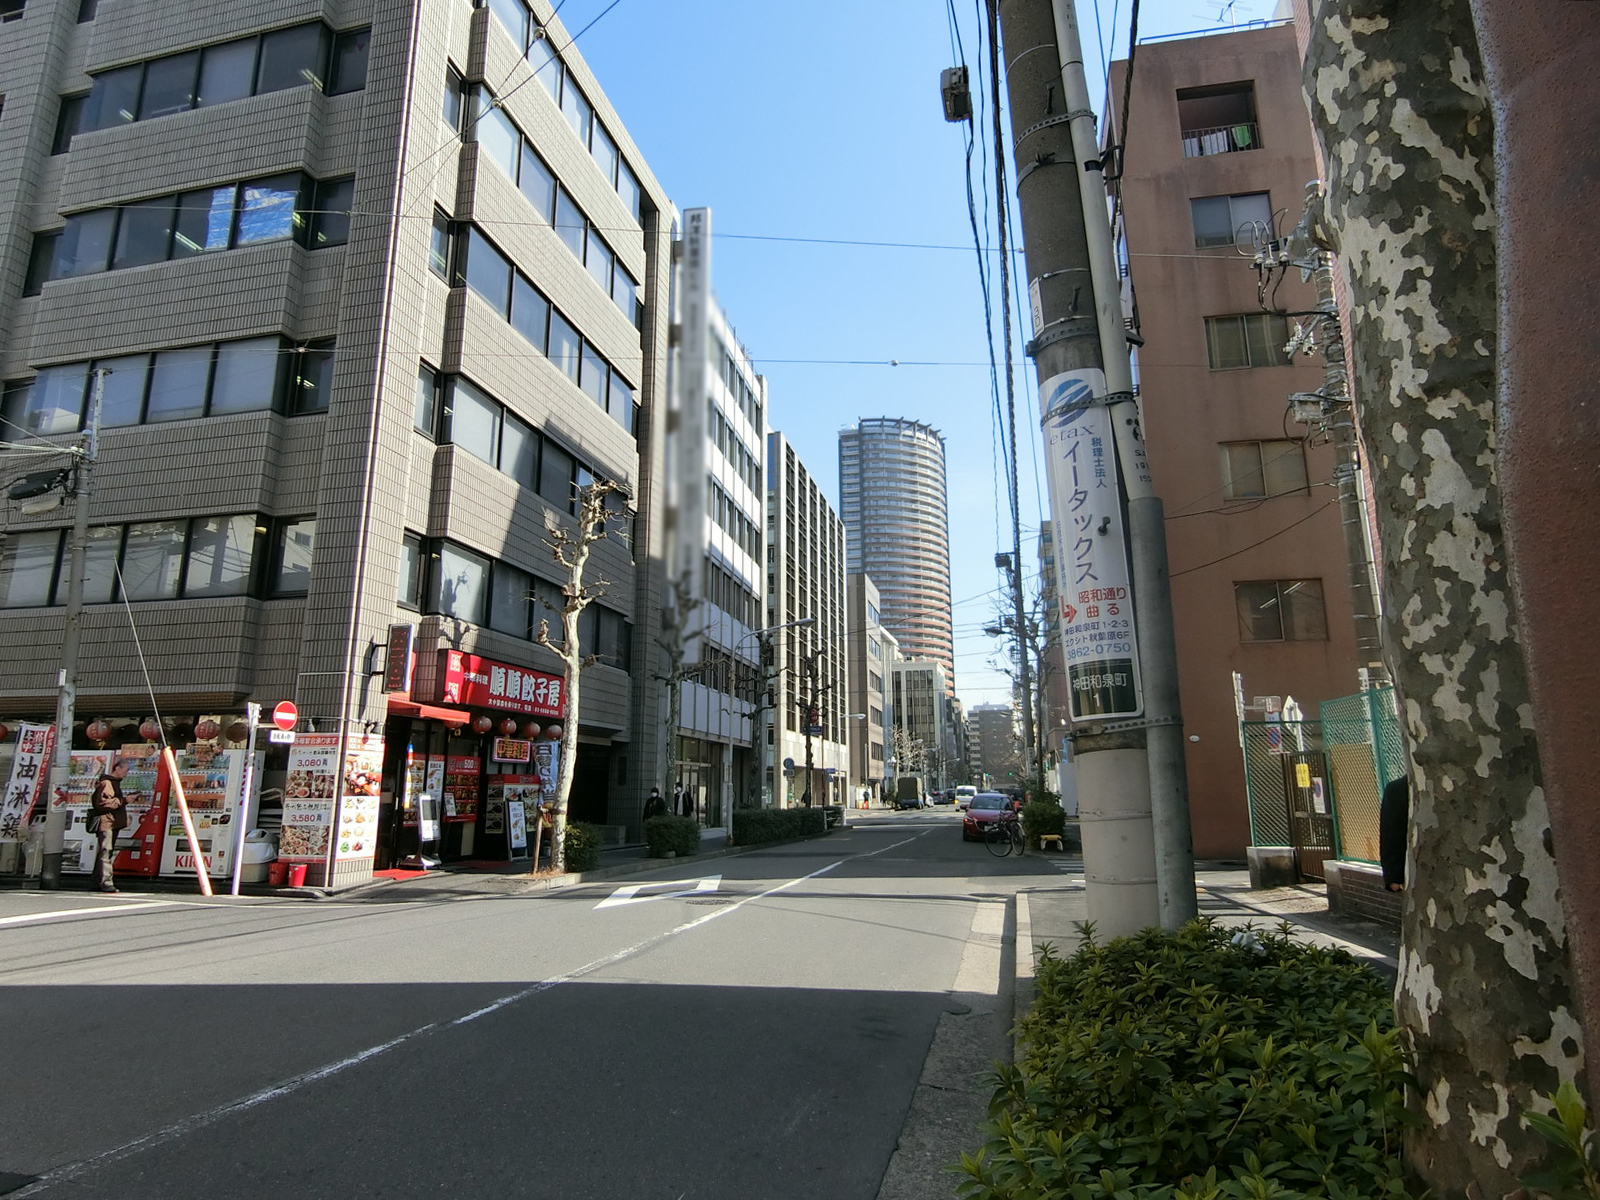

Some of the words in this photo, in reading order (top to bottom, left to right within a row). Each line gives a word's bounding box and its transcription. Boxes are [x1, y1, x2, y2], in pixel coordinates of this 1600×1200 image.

[1050, 424, 1096, 446] etax
[1091, 436, 1107, 489] 税理士法人
[1063, 440, 1098, 585] イータックス
[1078, 587, 1127, 604] 昭和通り
[1086, 602, 1120, 619] 曲る
[1064, 621, 1100, 636] 神田和泉町
[1102, 619, 1129, 630] 1-2-3
[1067, 642, 1132, 661] 3862-0750
[489, 664, 560, 708] 順順餃子房
[1072, 672, 1128, 692] 神田和泉町
[1093, 692, 1101, 708] 1
[175, 855, 213, 869] KIRN
